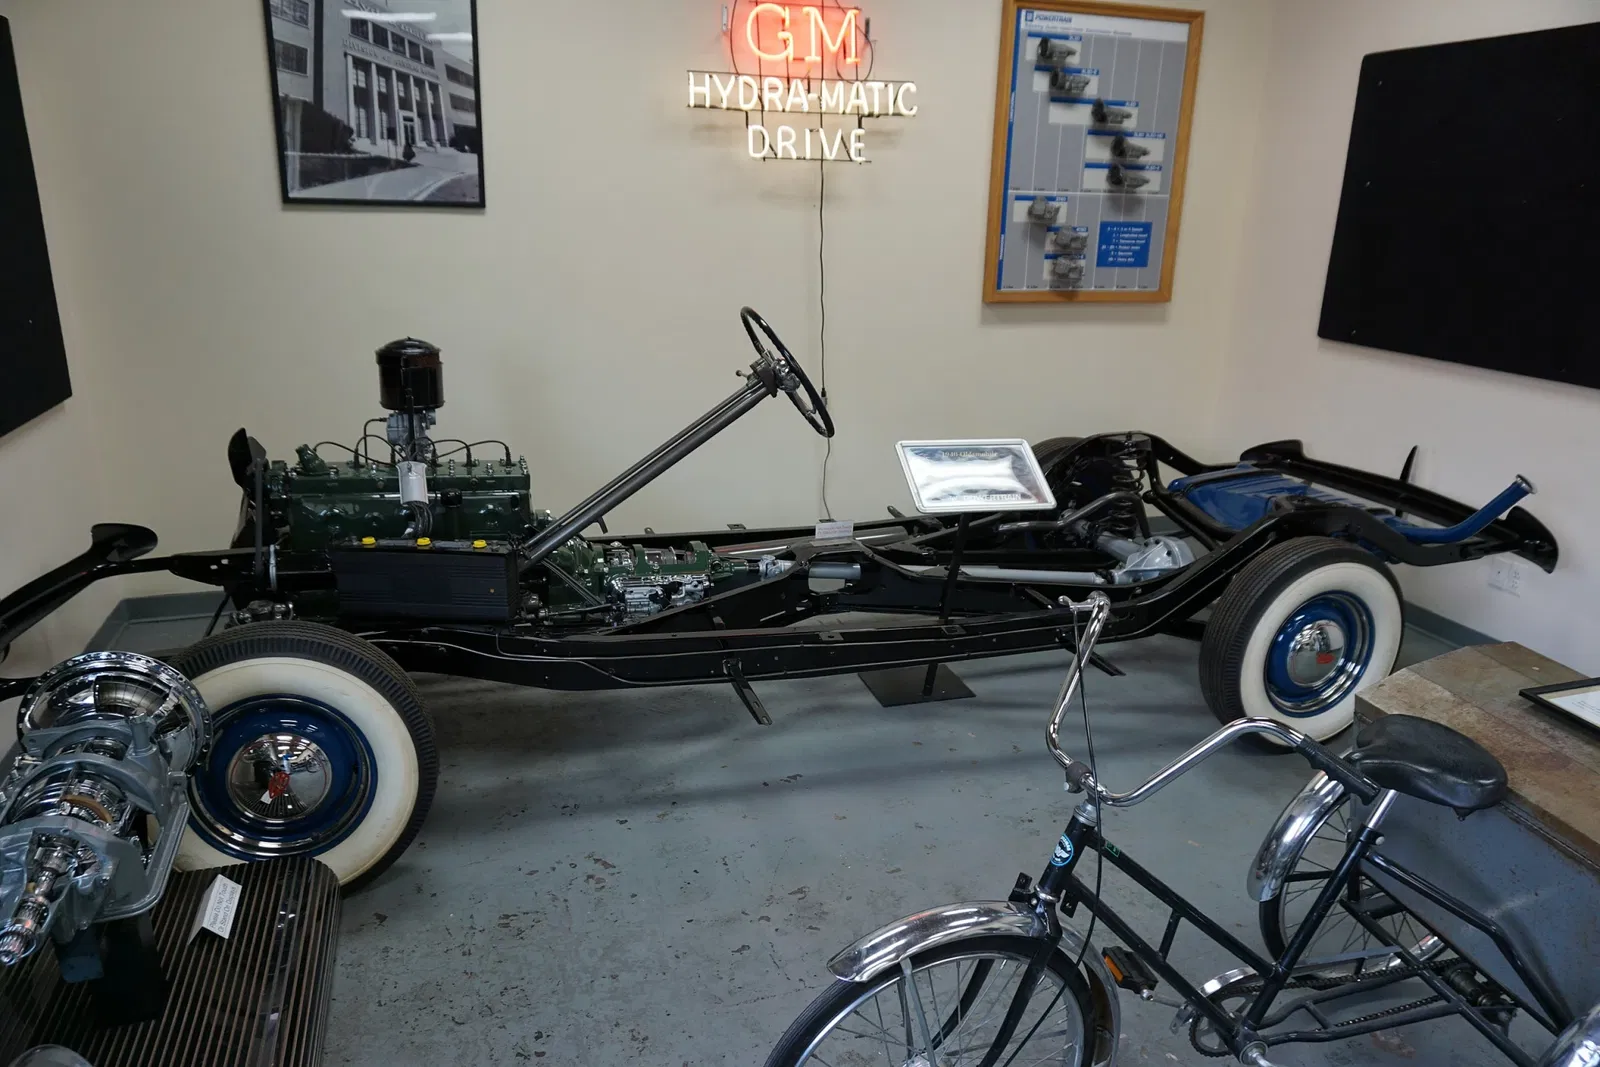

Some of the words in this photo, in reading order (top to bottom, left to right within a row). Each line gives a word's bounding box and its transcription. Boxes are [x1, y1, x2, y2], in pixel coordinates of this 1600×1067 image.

[746, 2, 861, 64] GM
[688, 71, 918, 116] HYDRA-MATIC
[747, 124, 867, 162] DRIVE
